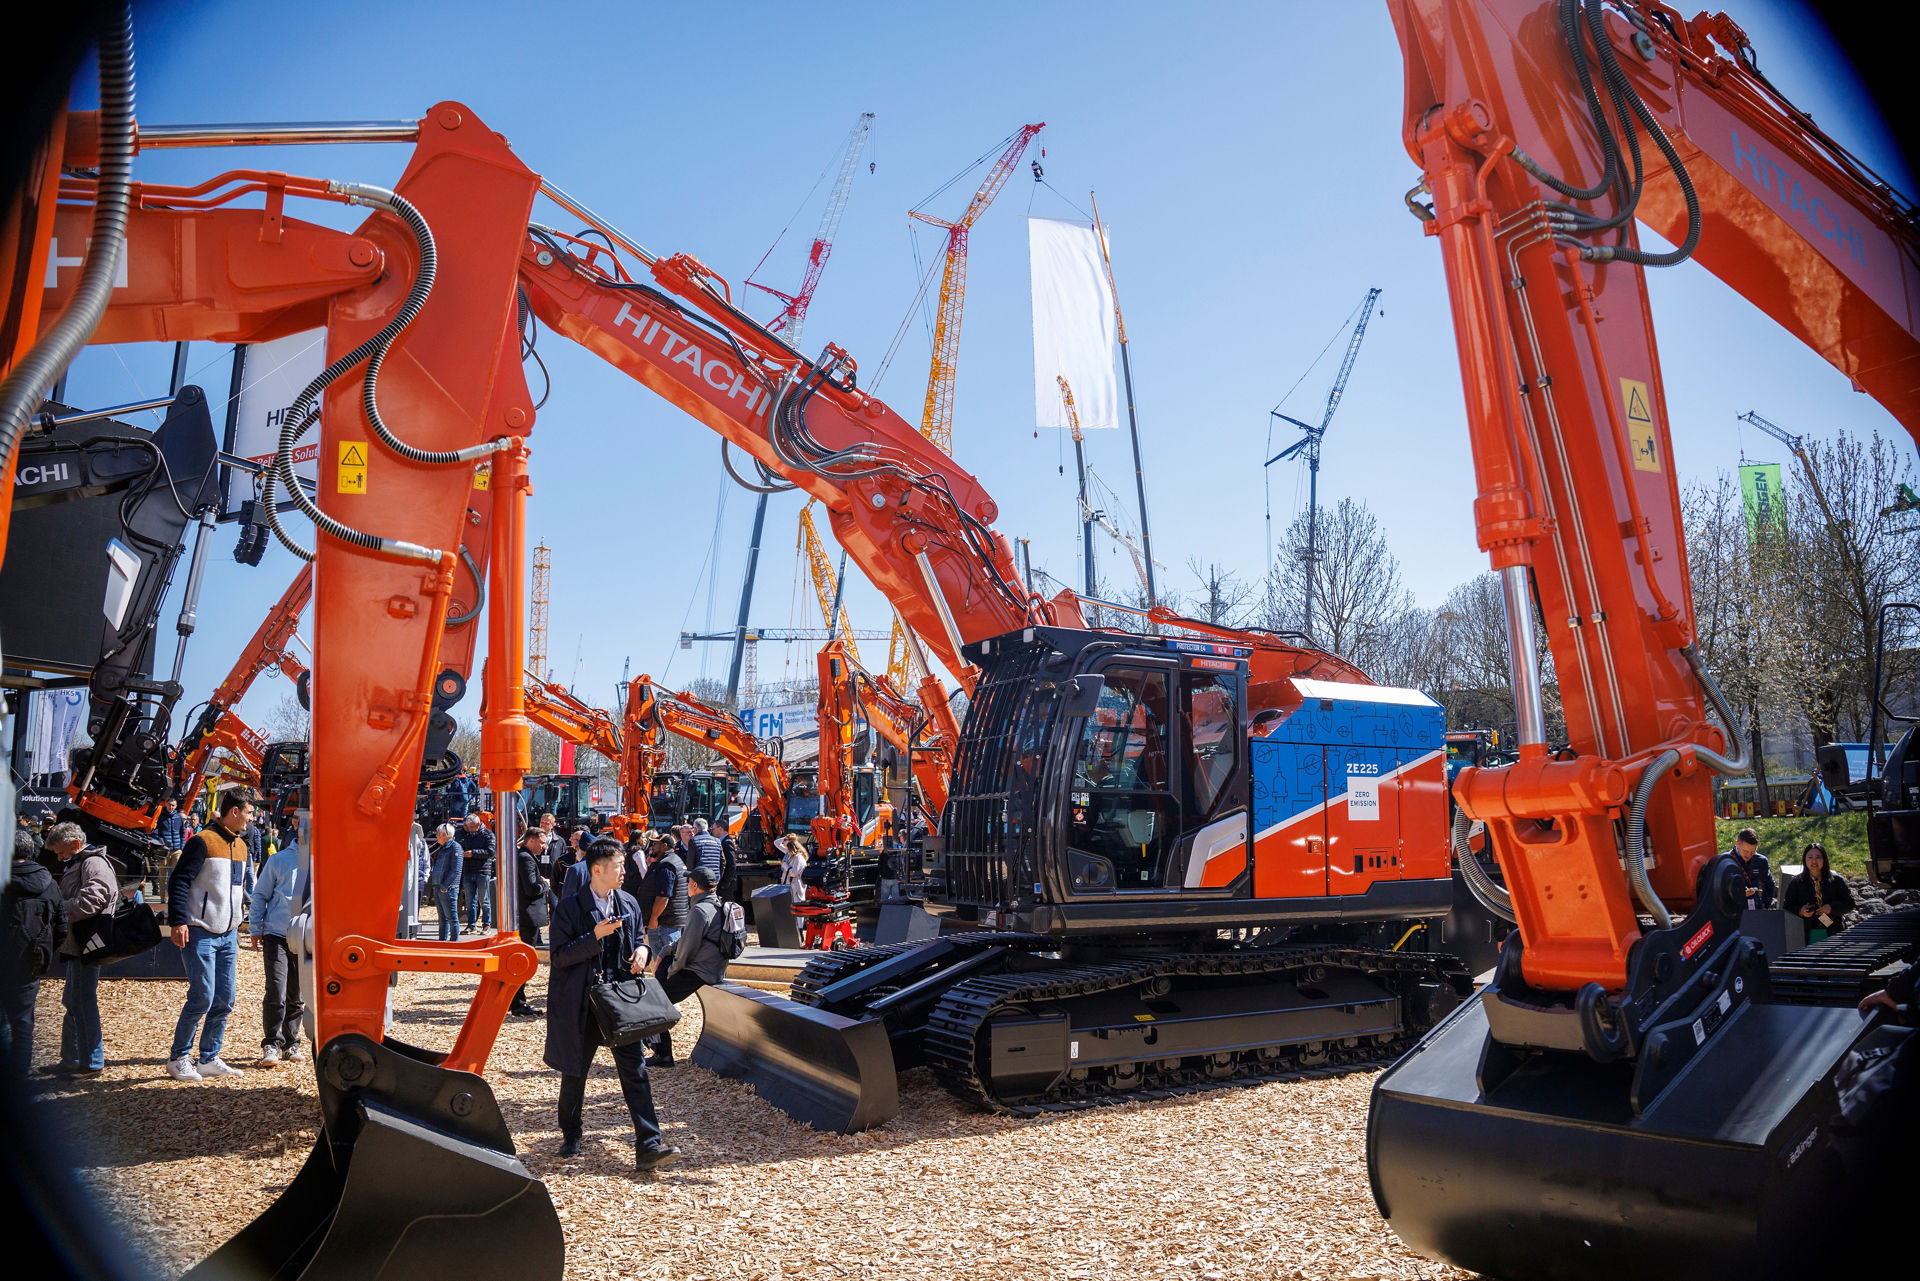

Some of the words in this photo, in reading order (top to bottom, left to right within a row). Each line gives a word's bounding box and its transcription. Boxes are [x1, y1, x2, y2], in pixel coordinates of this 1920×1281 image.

[1731, 129, 1866, 268] HITACHI
[613, 301, 773, 417] HITACHI
[1217, 646, 1228, 654] NEW
[1200, 660, 1227, 668] HITACHI
[678, 717, 707, 732] HITACHI
[758, 712, 783, 737] FM
[1346, 763, 1379, 774] ZE225
